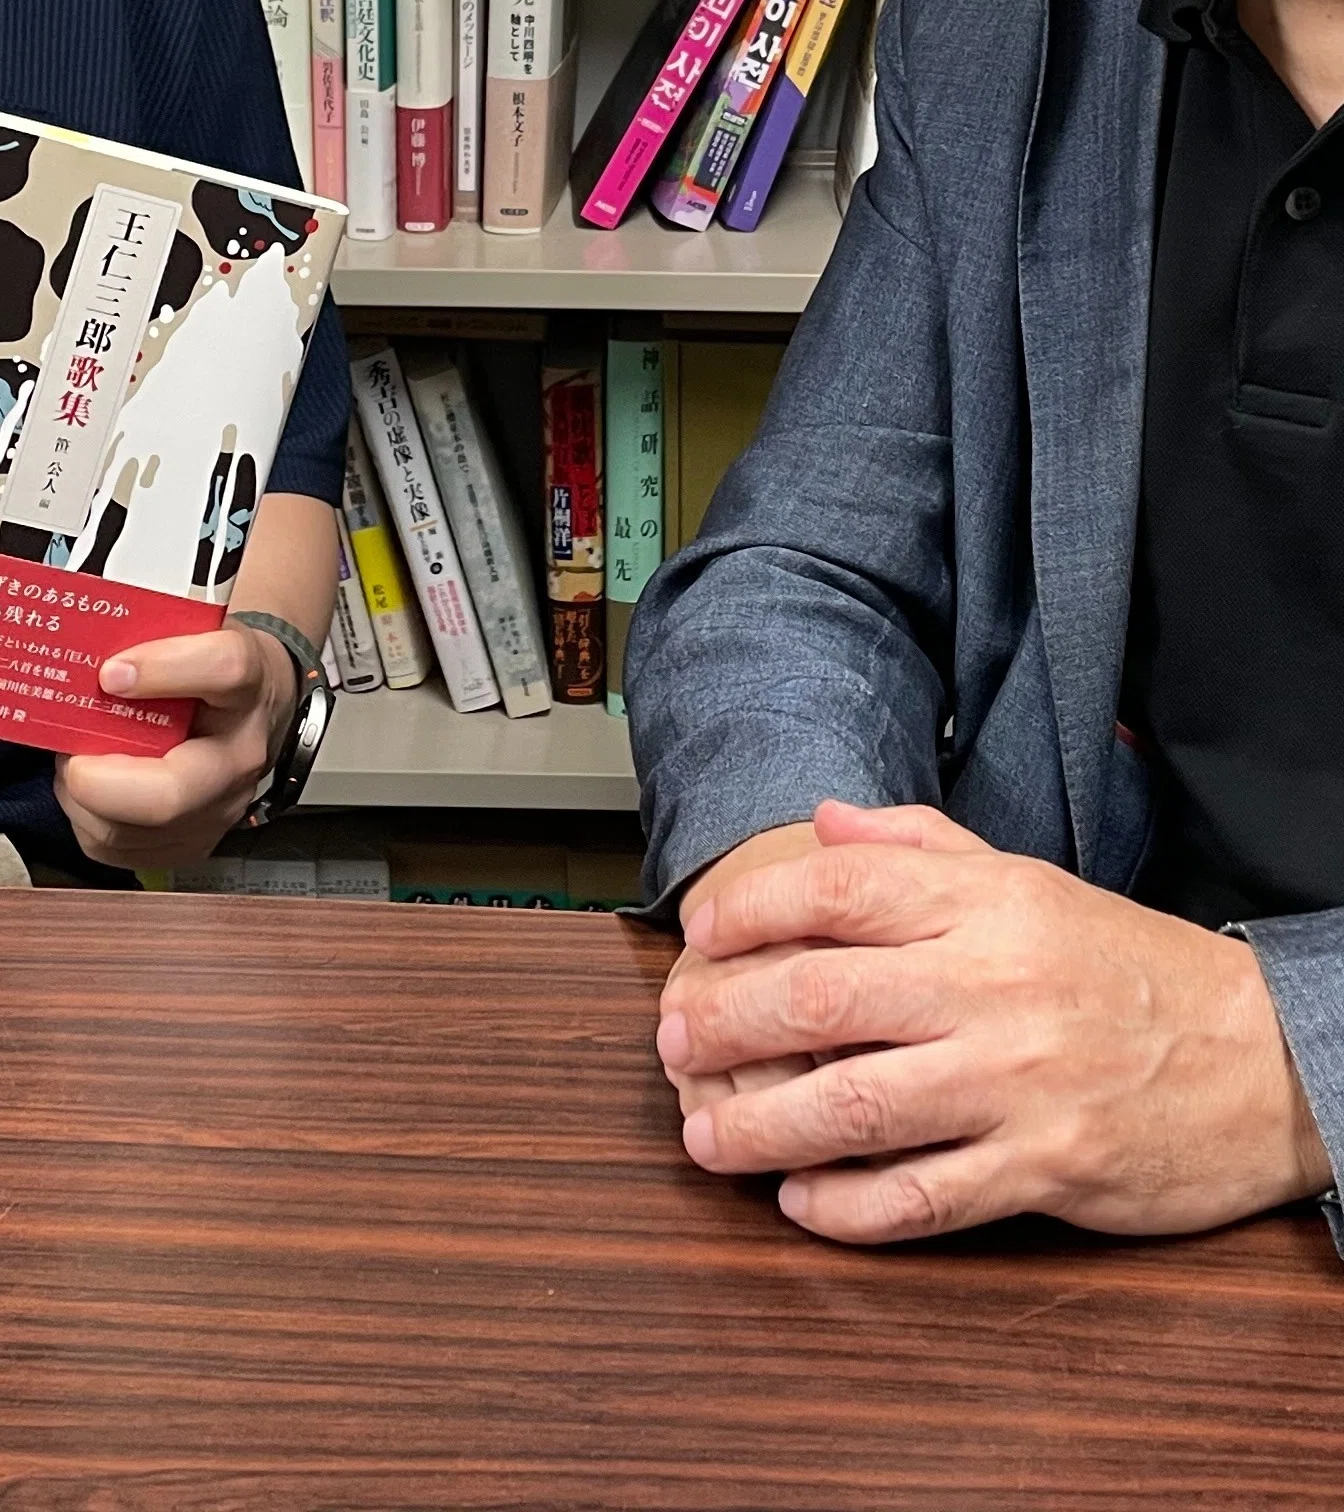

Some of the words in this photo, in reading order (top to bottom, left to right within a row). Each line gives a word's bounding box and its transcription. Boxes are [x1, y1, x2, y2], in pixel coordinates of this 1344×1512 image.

[732, 30, 783, 91] 사전
[511, 91, 525, 148] 根本文子
[53, 207, 152, 428] 王仁三郎歌集
[640, 347, 659, 539] 神話研究の
[613, 515, 633, 583] 最先
